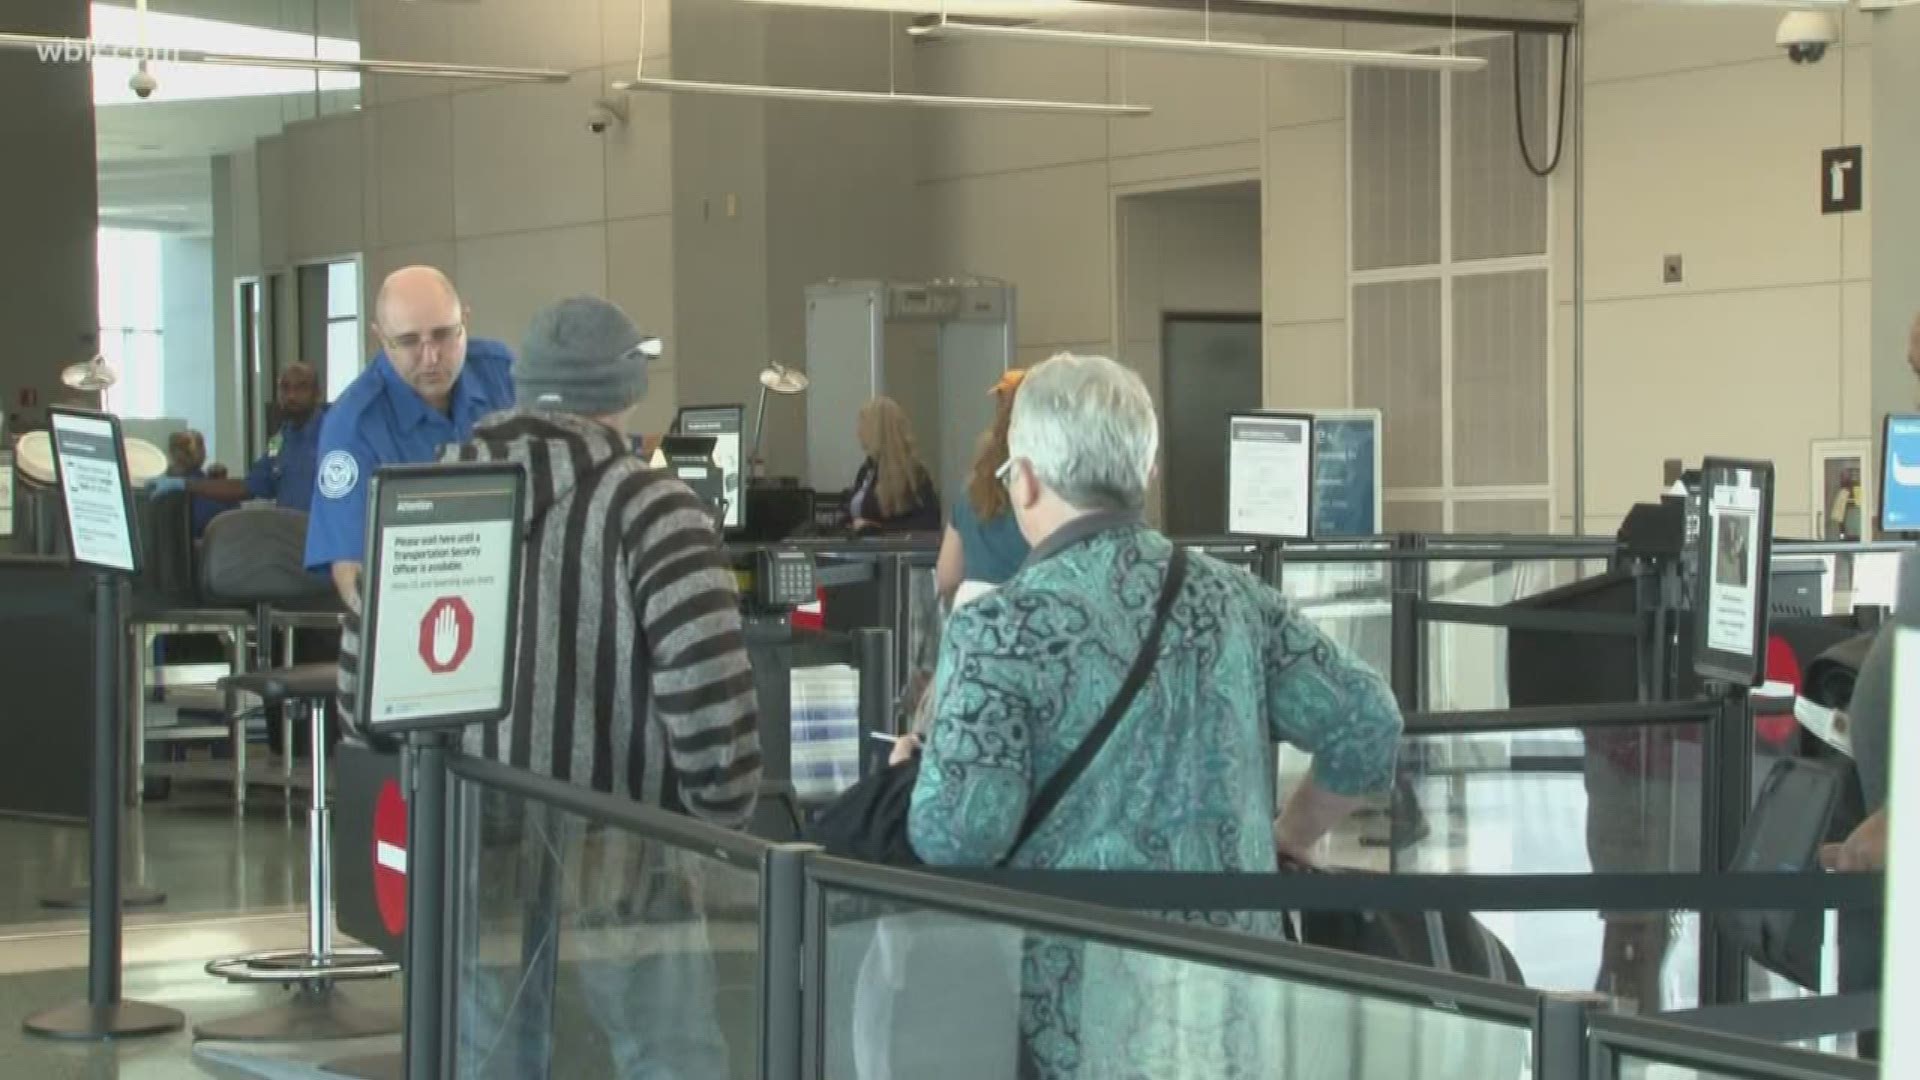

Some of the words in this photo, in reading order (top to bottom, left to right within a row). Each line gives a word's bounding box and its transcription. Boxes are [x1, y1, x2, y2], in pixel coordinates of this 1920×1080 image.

[395, 536, 419, 546] Please
[421, 534, 437, 545] wait
[439, 534, 456, 544] here
[457, 532, 474, 543] until
[394, 549, 450, 560] Transportation
[451, 546, 481, 558] Security
[393, 563, 418, 574] Officer
